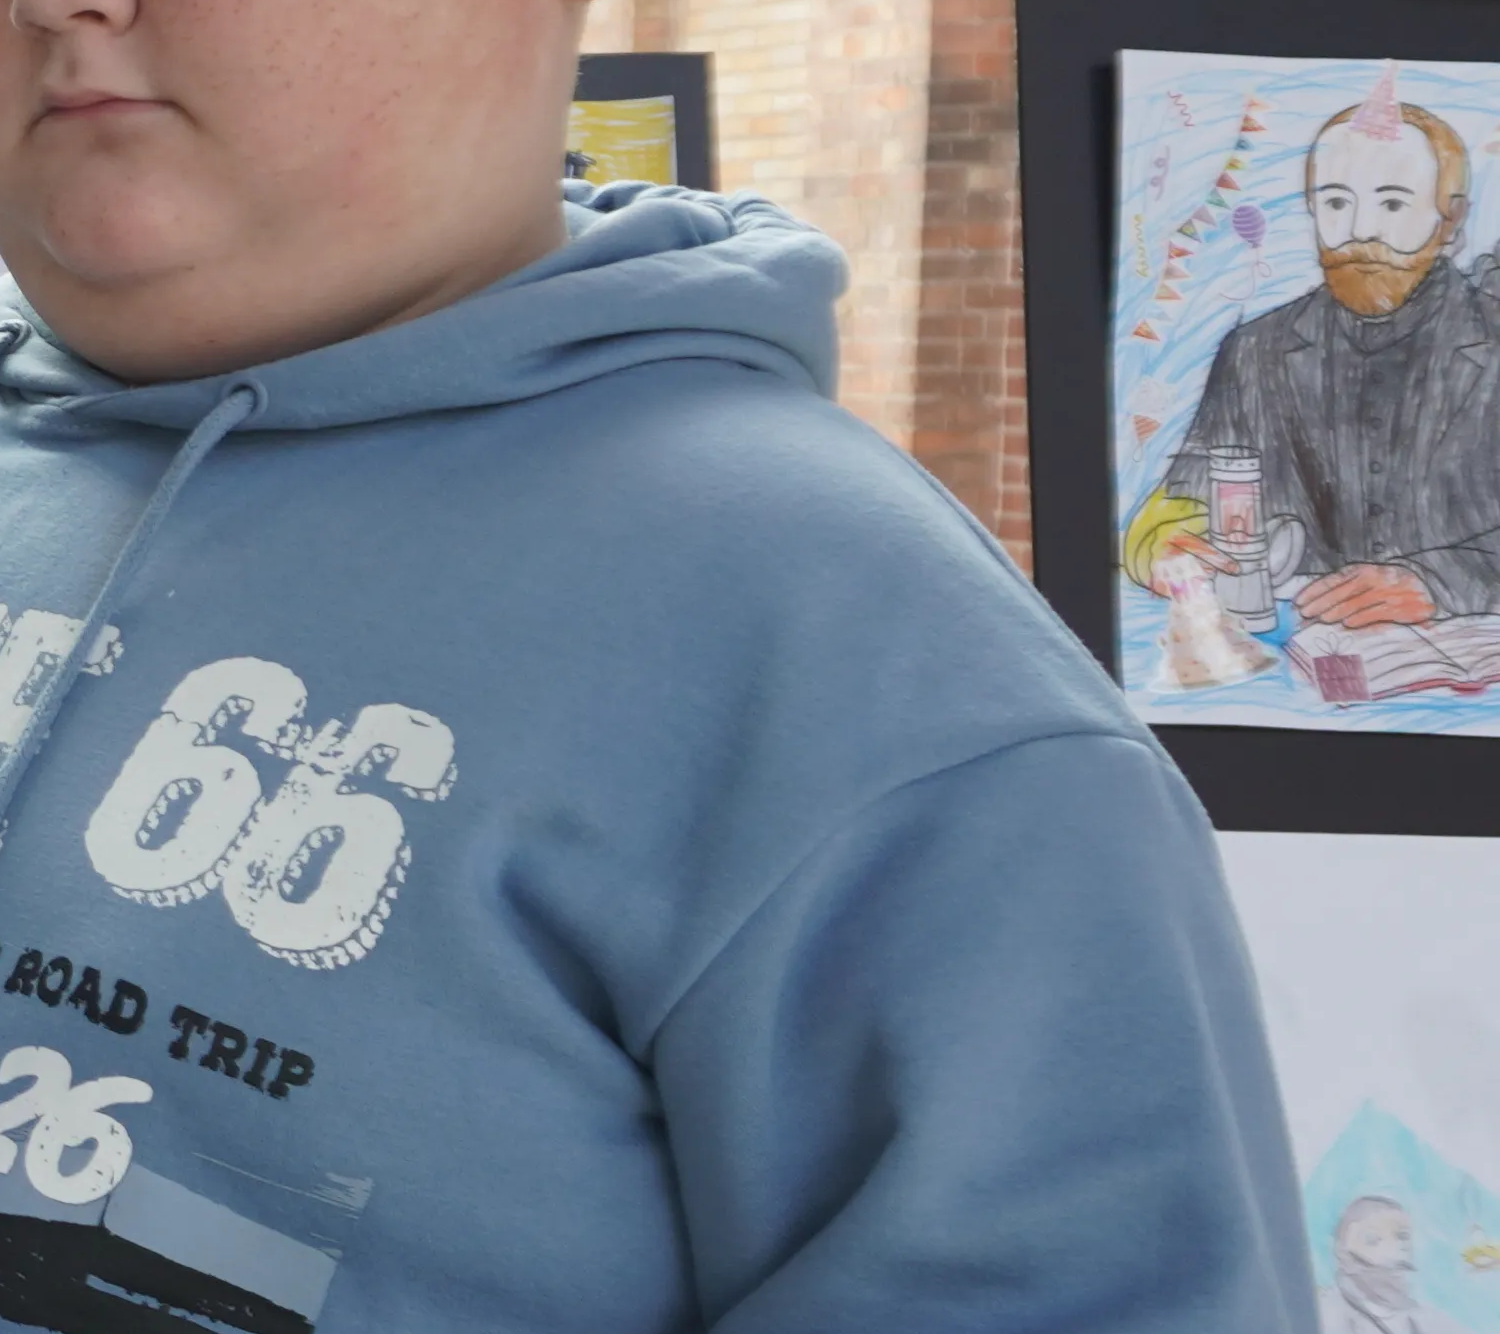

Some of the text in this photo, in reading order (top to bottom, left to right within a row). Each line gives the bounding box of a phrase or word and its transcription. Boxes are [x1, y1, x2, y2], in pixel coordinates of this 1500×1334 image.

[85, 656, 457, 971] 66
[4, 947, 149, 1035] ROAD
[168, 1005, 315, 1099] TRIP
